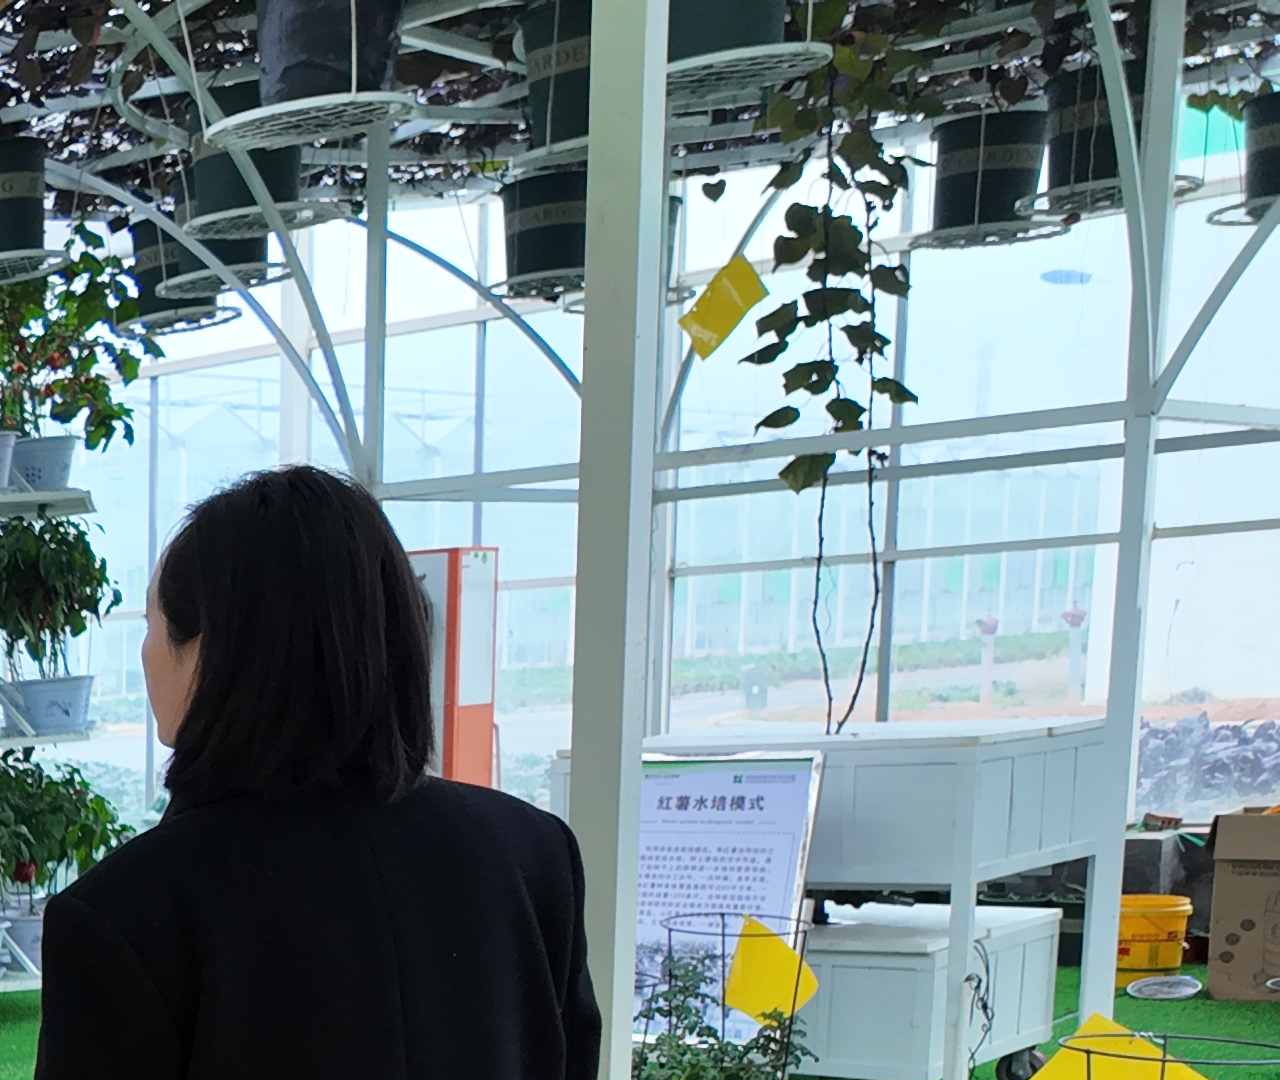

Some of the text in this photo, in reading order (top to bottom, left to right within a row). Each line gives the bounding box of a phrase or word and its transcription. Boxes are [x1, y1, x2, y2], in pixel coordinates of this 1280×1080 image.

[656, 794, 766, 812] 红薯水培模式
